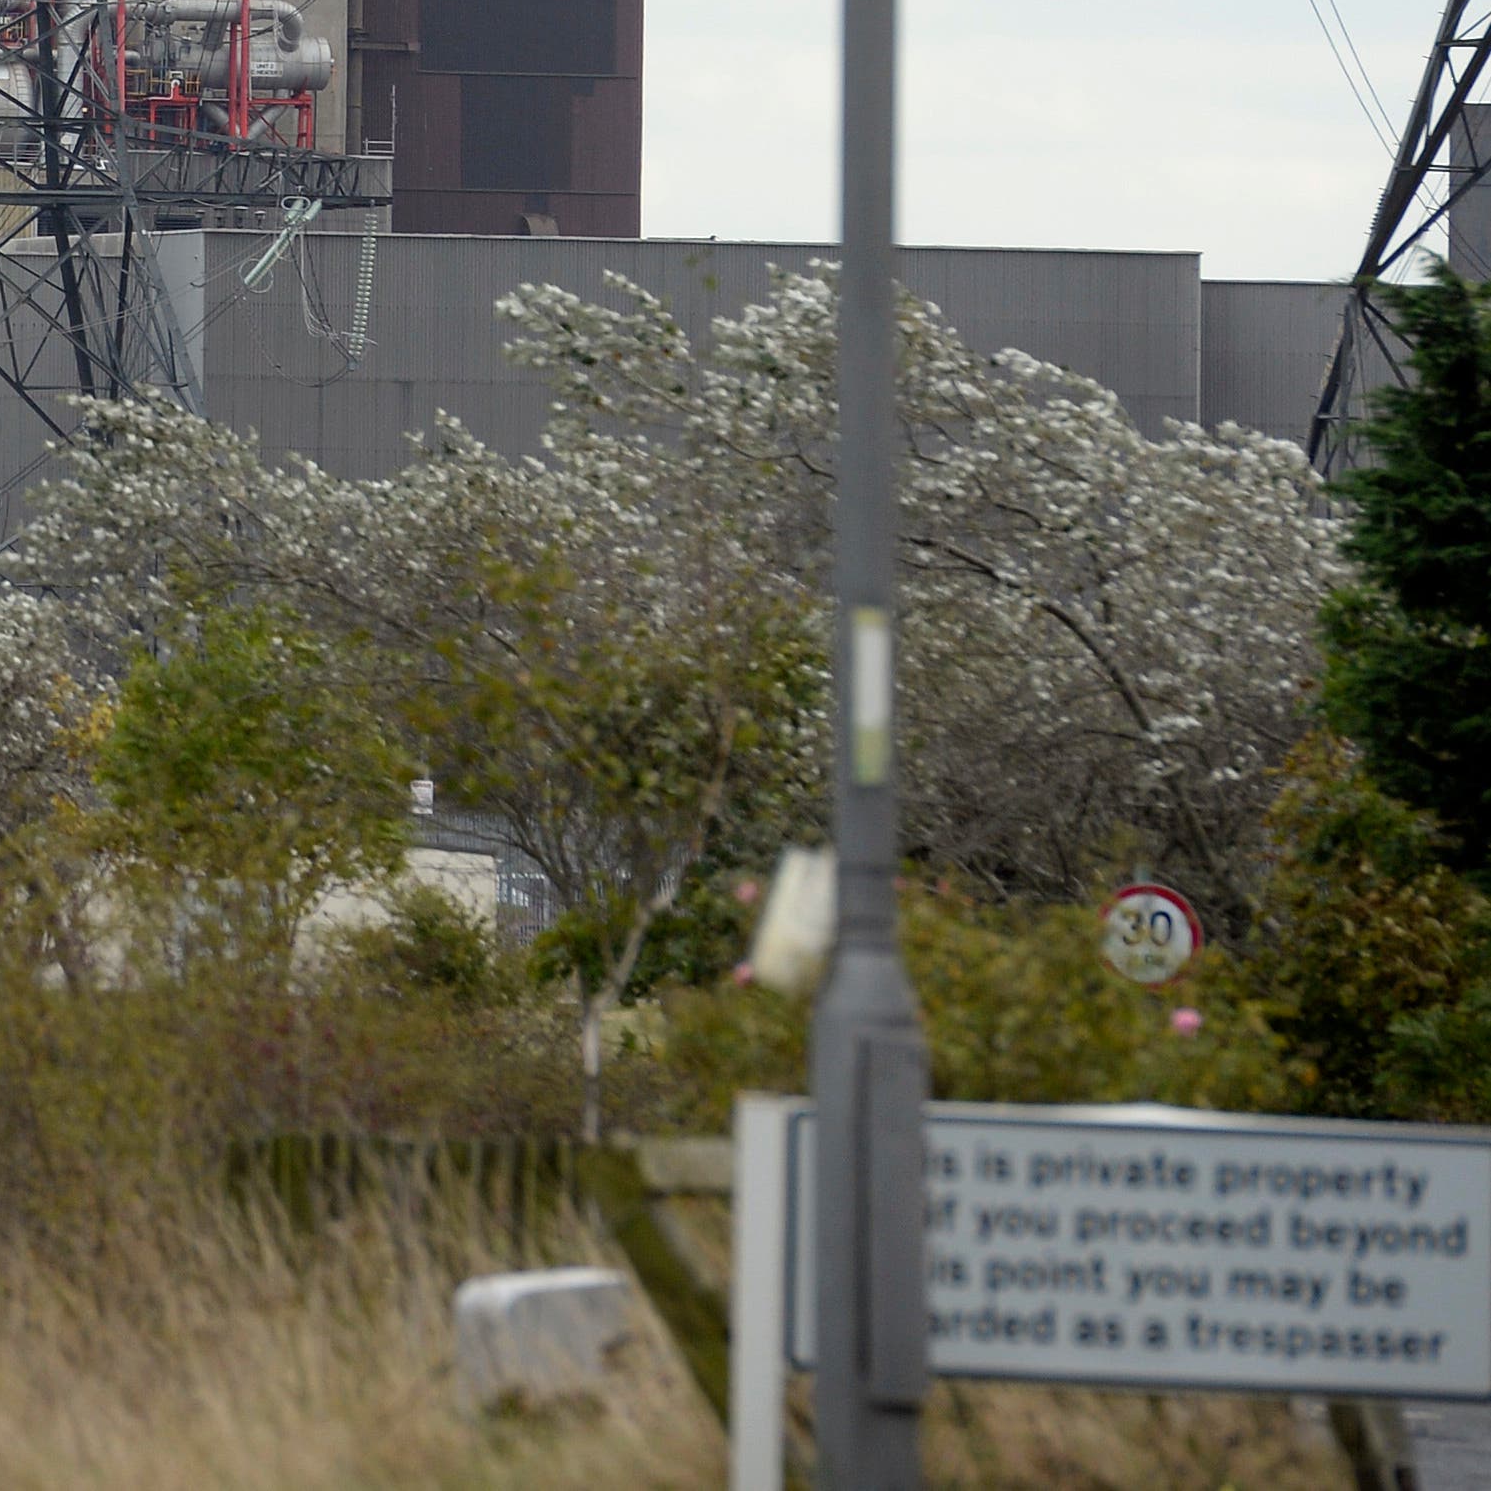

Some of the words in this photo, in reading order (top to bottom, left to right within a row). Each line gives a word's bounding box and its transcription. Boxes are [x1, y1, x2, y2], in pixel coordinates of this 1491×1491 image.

[1122, 910, 1172, 946] 30
[975, 1143, 1013, 1180] is
[1028, 1146, 1196, 1189] private
[1214, 1159, 1428, 1207] property
[975, 1206, 1059, 1244] you
[1074, 1208, 1272, 1248] proceed
[1287, 1209, 1469, 1260] beyond
[929, 1252, 968, 1284] is
[984, 1251, 1108, 1294] point
[1125, 1264, 1211, 1305] you
[1226, 1267, 1330, 1311] may
[1345, 1264, 1407, 1308] be
[1073, 1316, 1126, 1349] as
[1143, 1316, 1169, 1351] a
[1185, 1311, 1448, 1363] trespasser
